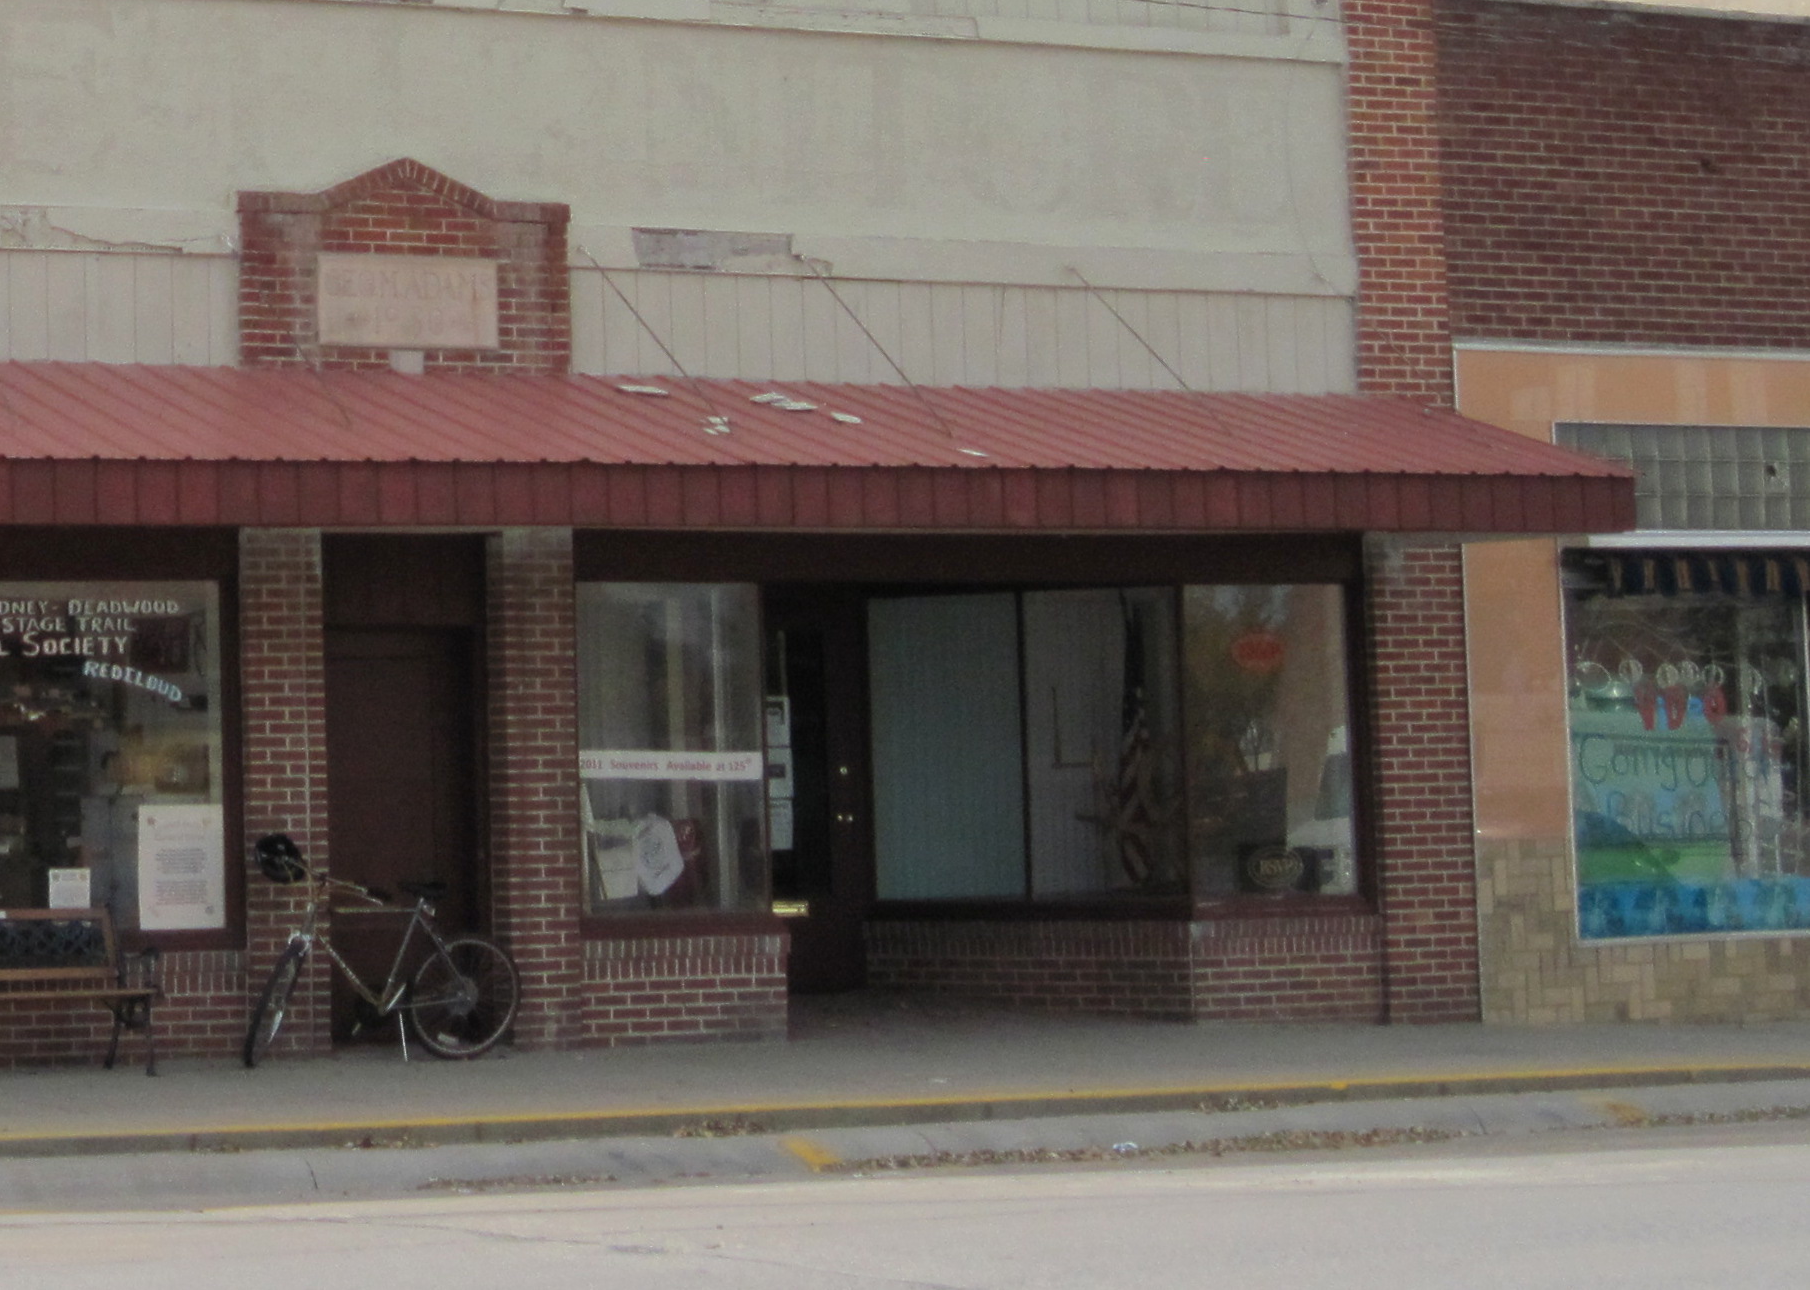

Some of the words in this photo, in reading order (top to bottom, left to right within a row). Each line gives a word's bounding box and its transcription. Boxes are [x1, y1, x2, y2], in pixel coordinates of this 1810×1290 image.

[2, 617, 66, 634] STAGE
[78, 616, 136, 632] TRAIL
[22, 630, 128, 657] SOCIETY
[580, 759, 602, 770] 2011
[610, 759, 658, 771] Souvenirs
[666, 760, 712, 772] Available
